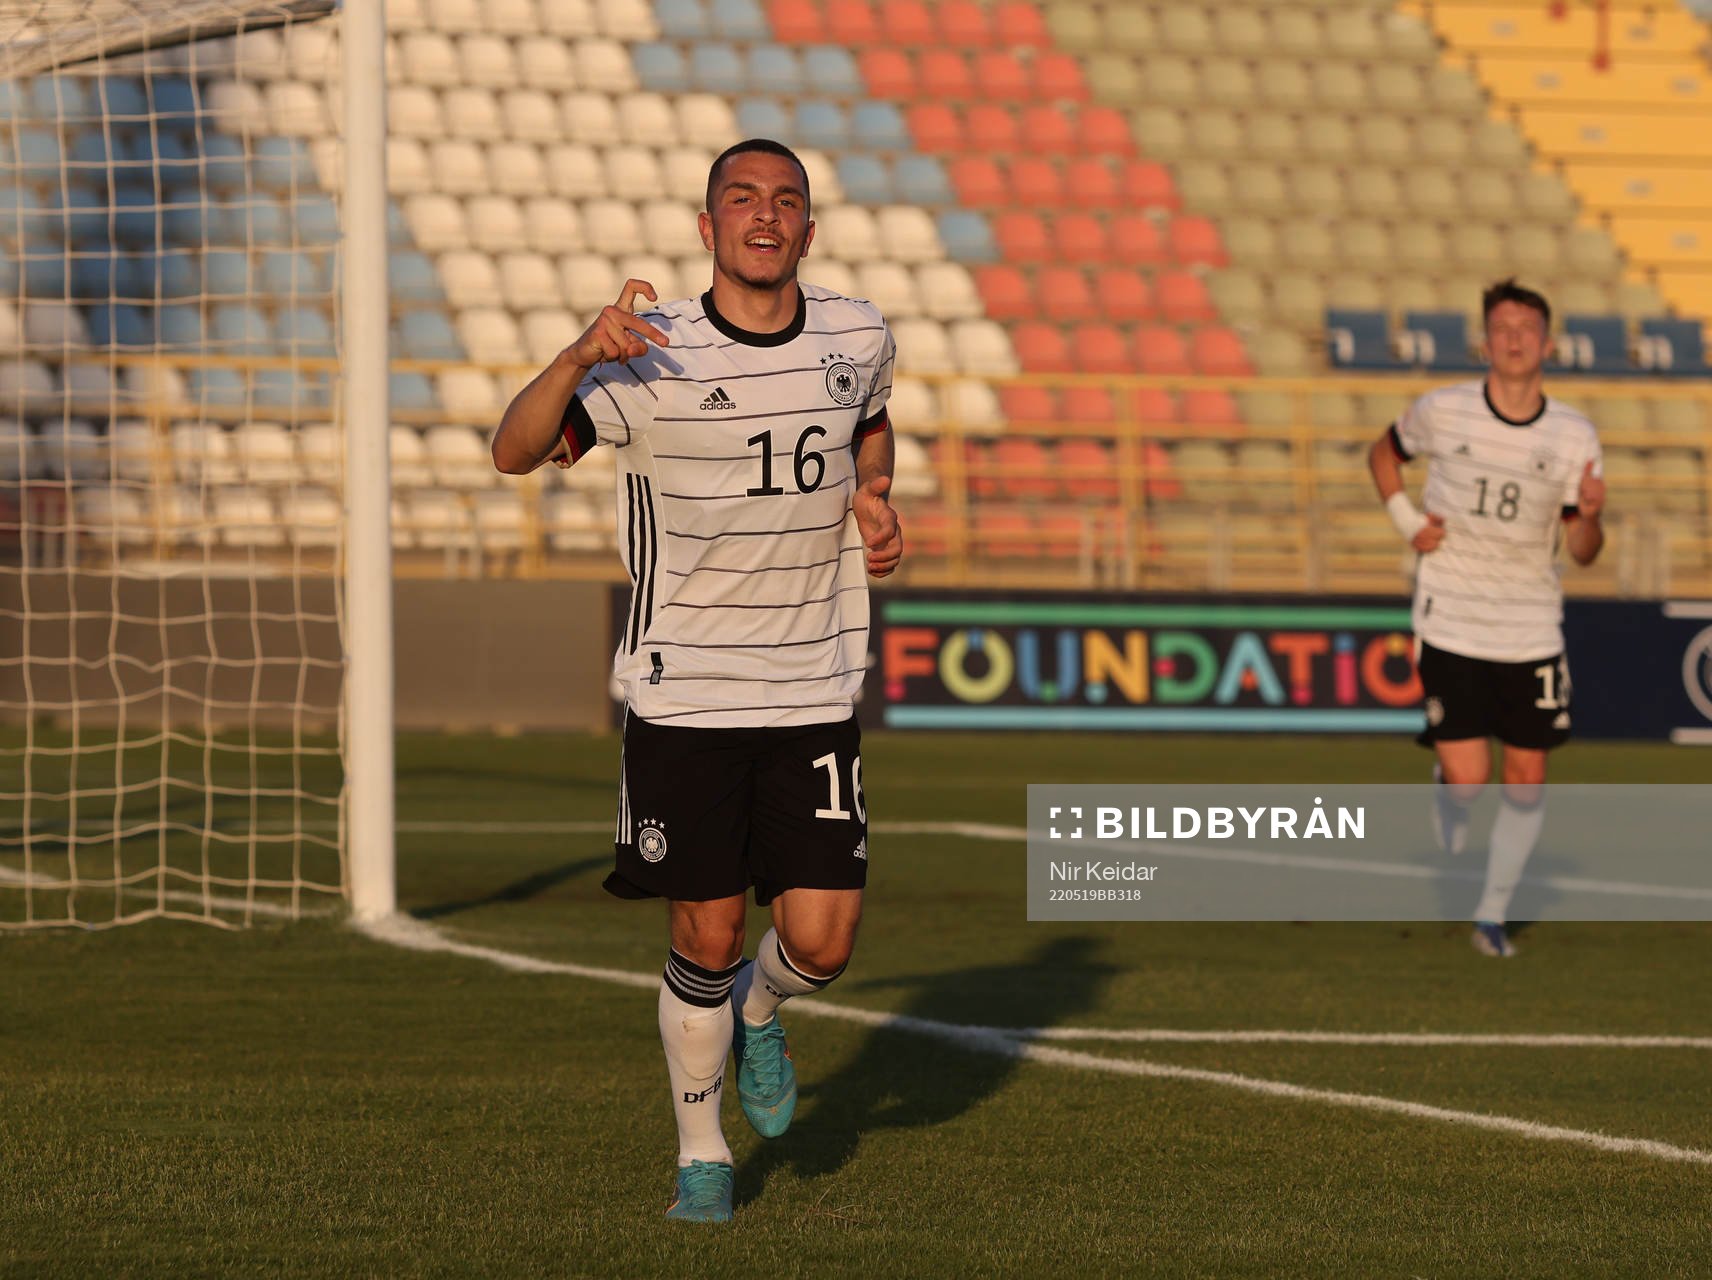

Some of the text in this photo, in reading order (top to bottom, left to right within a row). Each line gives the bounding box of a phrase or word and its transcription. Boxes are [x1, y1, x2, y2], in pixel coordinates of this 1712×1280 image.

[699, 401, 737, 411] adidas
[746, 424, 828, 497] 16
[1469, 477, 1521, 523] 18
[683, 1075, 722, 1104] DFB
